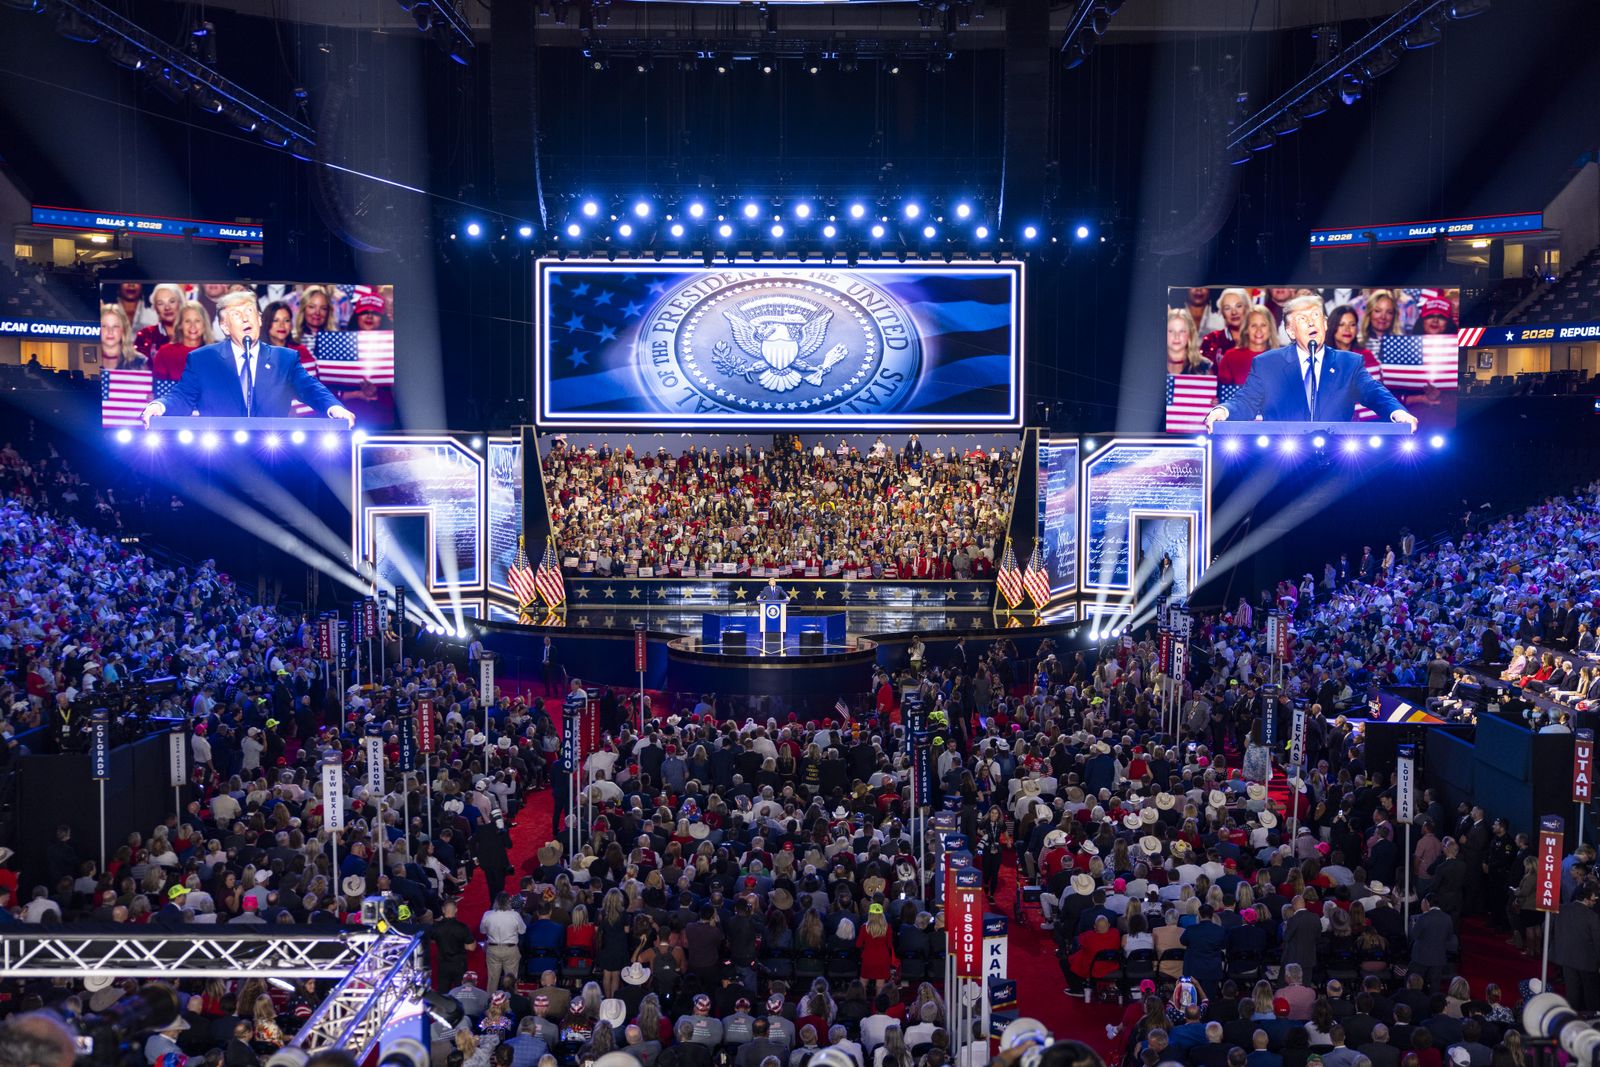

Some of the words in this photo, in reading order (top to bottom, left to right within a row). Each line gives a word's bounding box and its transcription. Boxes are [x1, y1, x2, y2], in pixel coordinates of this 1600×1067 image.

[96, 217, 125, 227] DALLAS
[219, 228, 248, 237] DALLAS
[1408, 226, 1437, 236] DALLAS
[0, 321, 29, 333] ICAN
[30, 323, 101, 336] CONVENTION
[846, 281, 909, 351] UNITED
[1521, 327, 1555, 340] 2026
[652, 339, 670, 367] THE
[657, 369, 679, 388] OF
[321, 623, 329, 658] NEVADA
[1175, 647, 1183, 681] OHIO
[422, 703, 431, 751] NEBRASKA
[1265, 698, 1273, 744] MINNESOTA
[1292, 713, 1303, 762] TEXAS
[96, 724, 105, 776] COLORADO
[564, 719, 572, 769] IDAHO
[329, 769, 337, 788] NEW
[372, 740, 380, 793] OKLAHOMA
[1575, 746, 1589, 797] UTAH
[329, 790, 338, 828] MEXICO
[1542, 837, 1556, 907] MICHIGAN
[963, 893, 974, 973] MISSOURI
